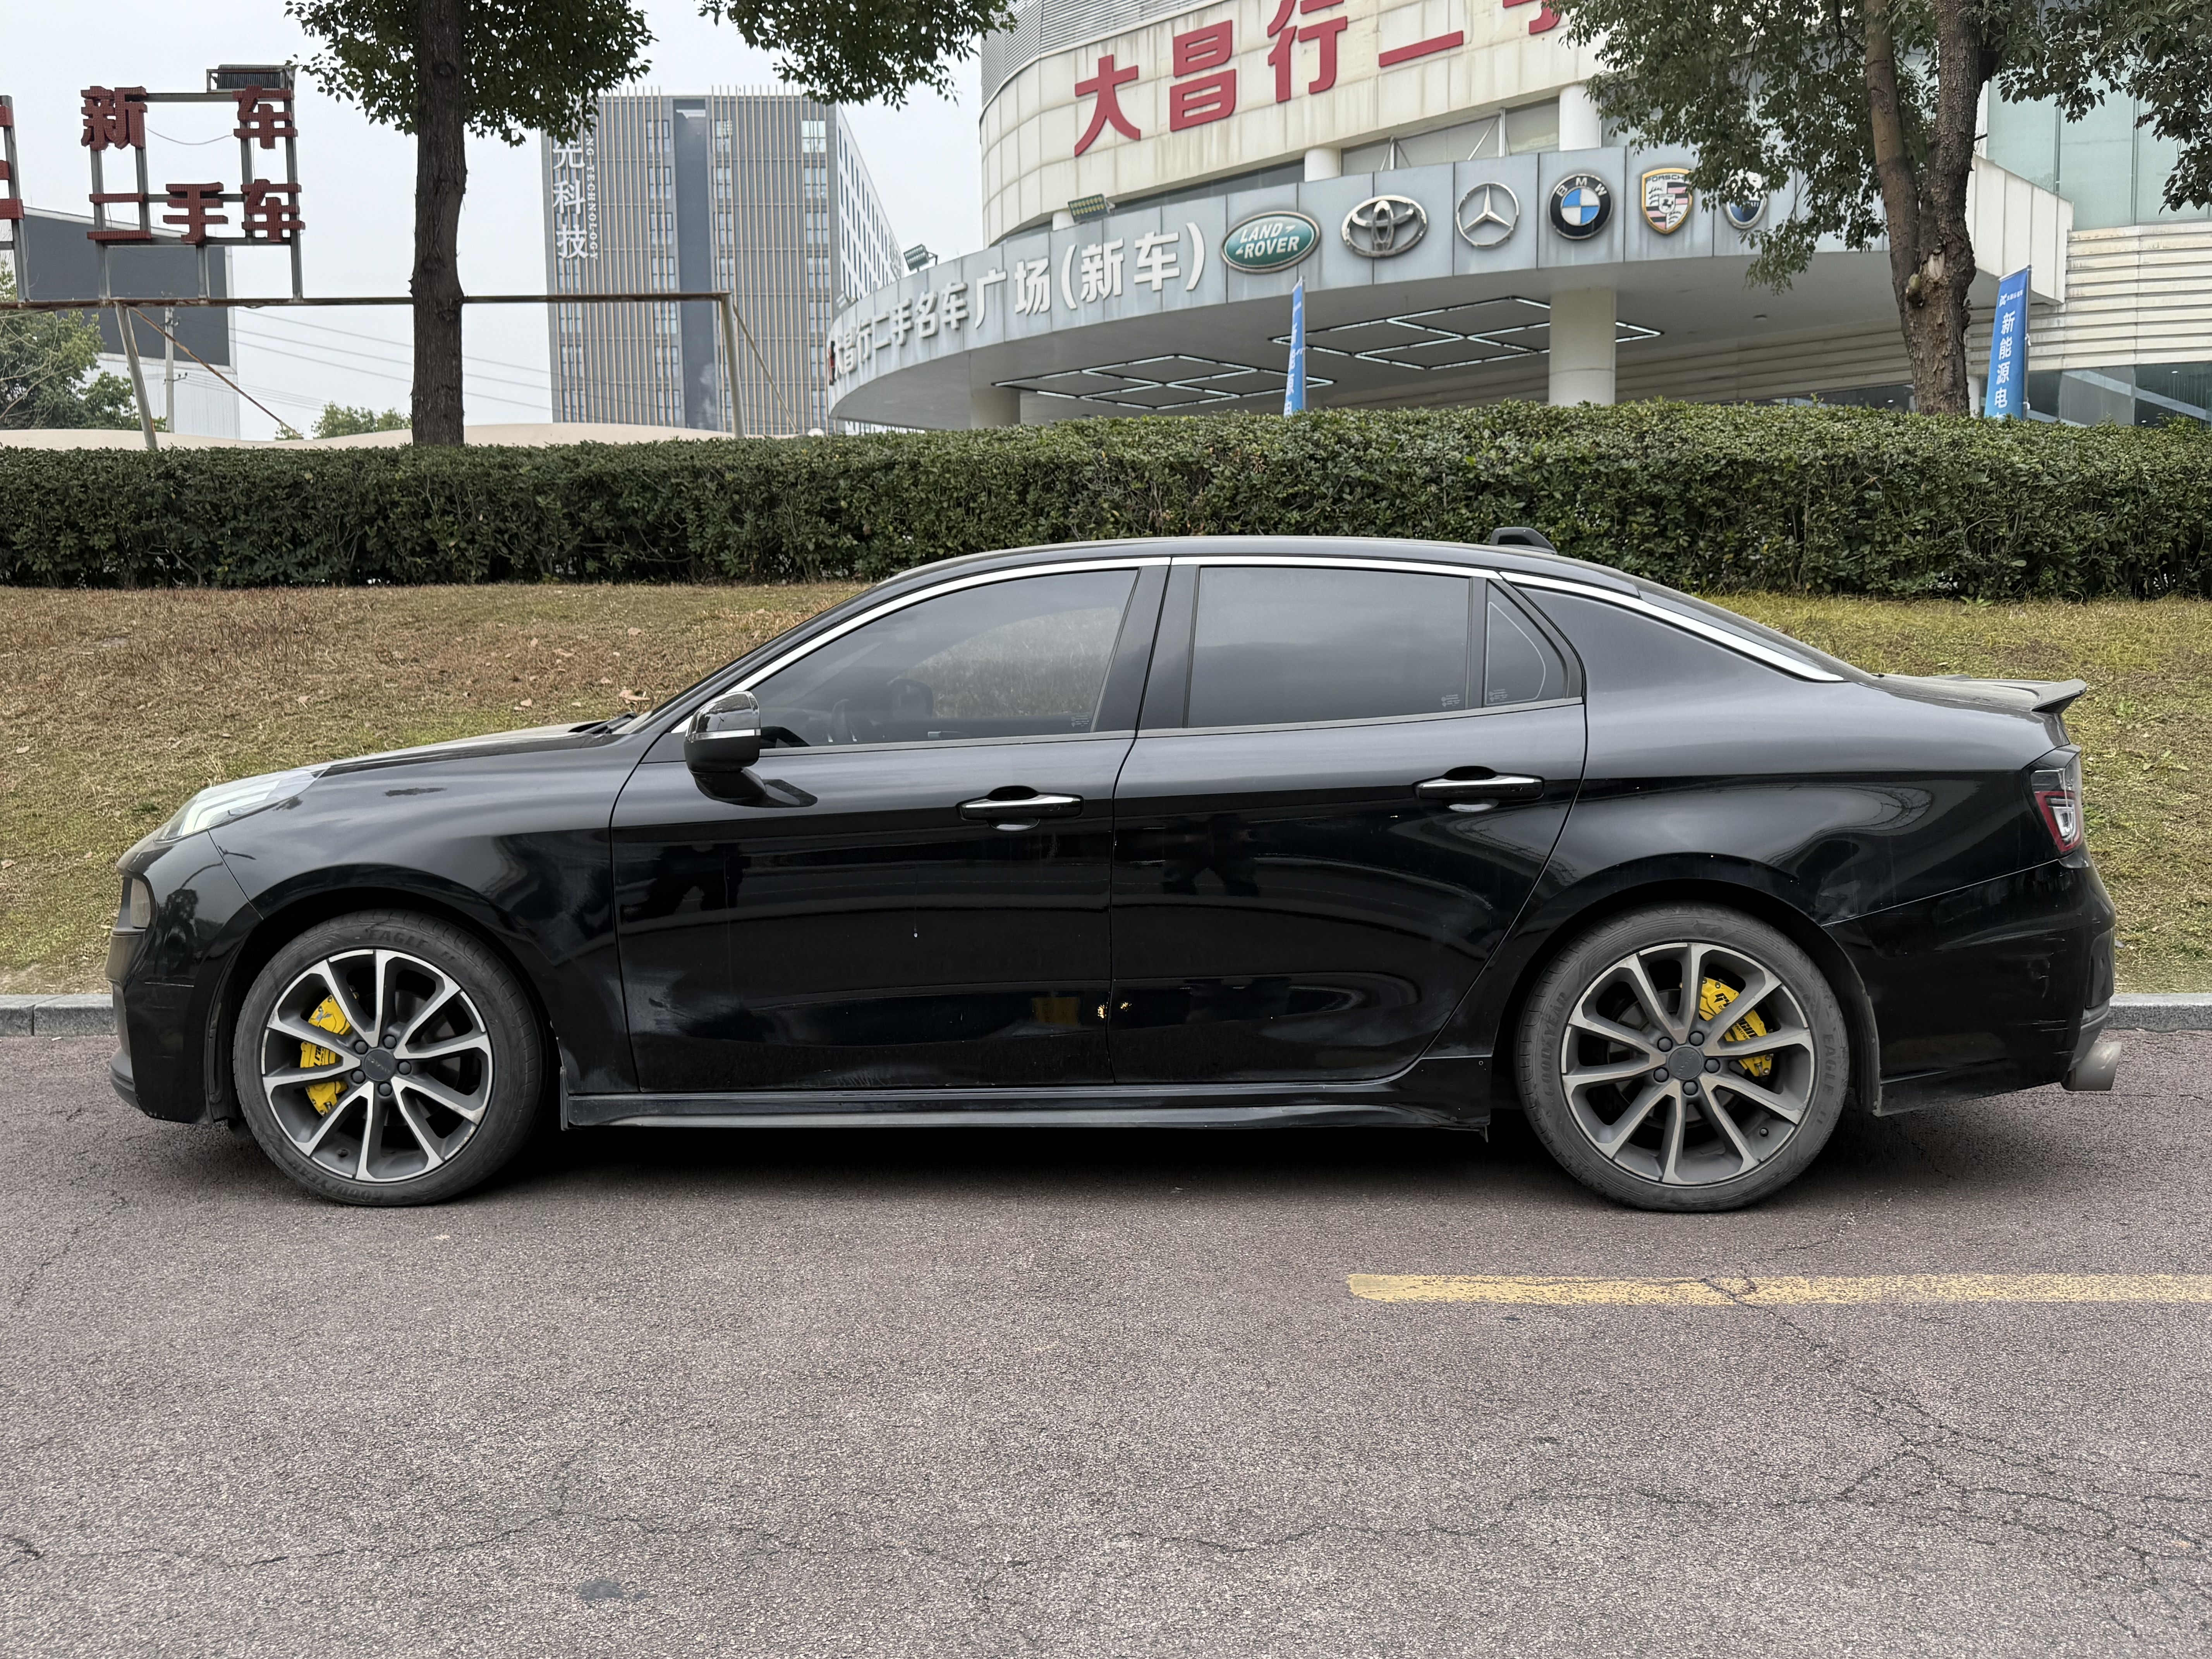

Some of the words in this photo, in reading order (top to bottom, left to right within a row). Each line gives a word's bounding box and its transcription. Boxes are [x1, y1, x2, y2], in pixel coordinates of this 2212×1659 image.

[1074, 0, 1561, 156] 大昌行
[81, 85, 299, 151] 新车
[1556, 177, 1607, 197] BMW
[1646, 174, 1686, 184] PORSCH
[87, 179, 306, 244] 二手车
[586, 165, 598, 260] TECHNOLOGY
[1240, 223, 1283, 243] LAND
[1244, 236, 1300, 259] ROVER
[368, 929, 428, 948] EAGLE
[1541, 992, 1567, 1096] GOODYEAR
[1823, 1034, 1836, 1096] EAGLE
